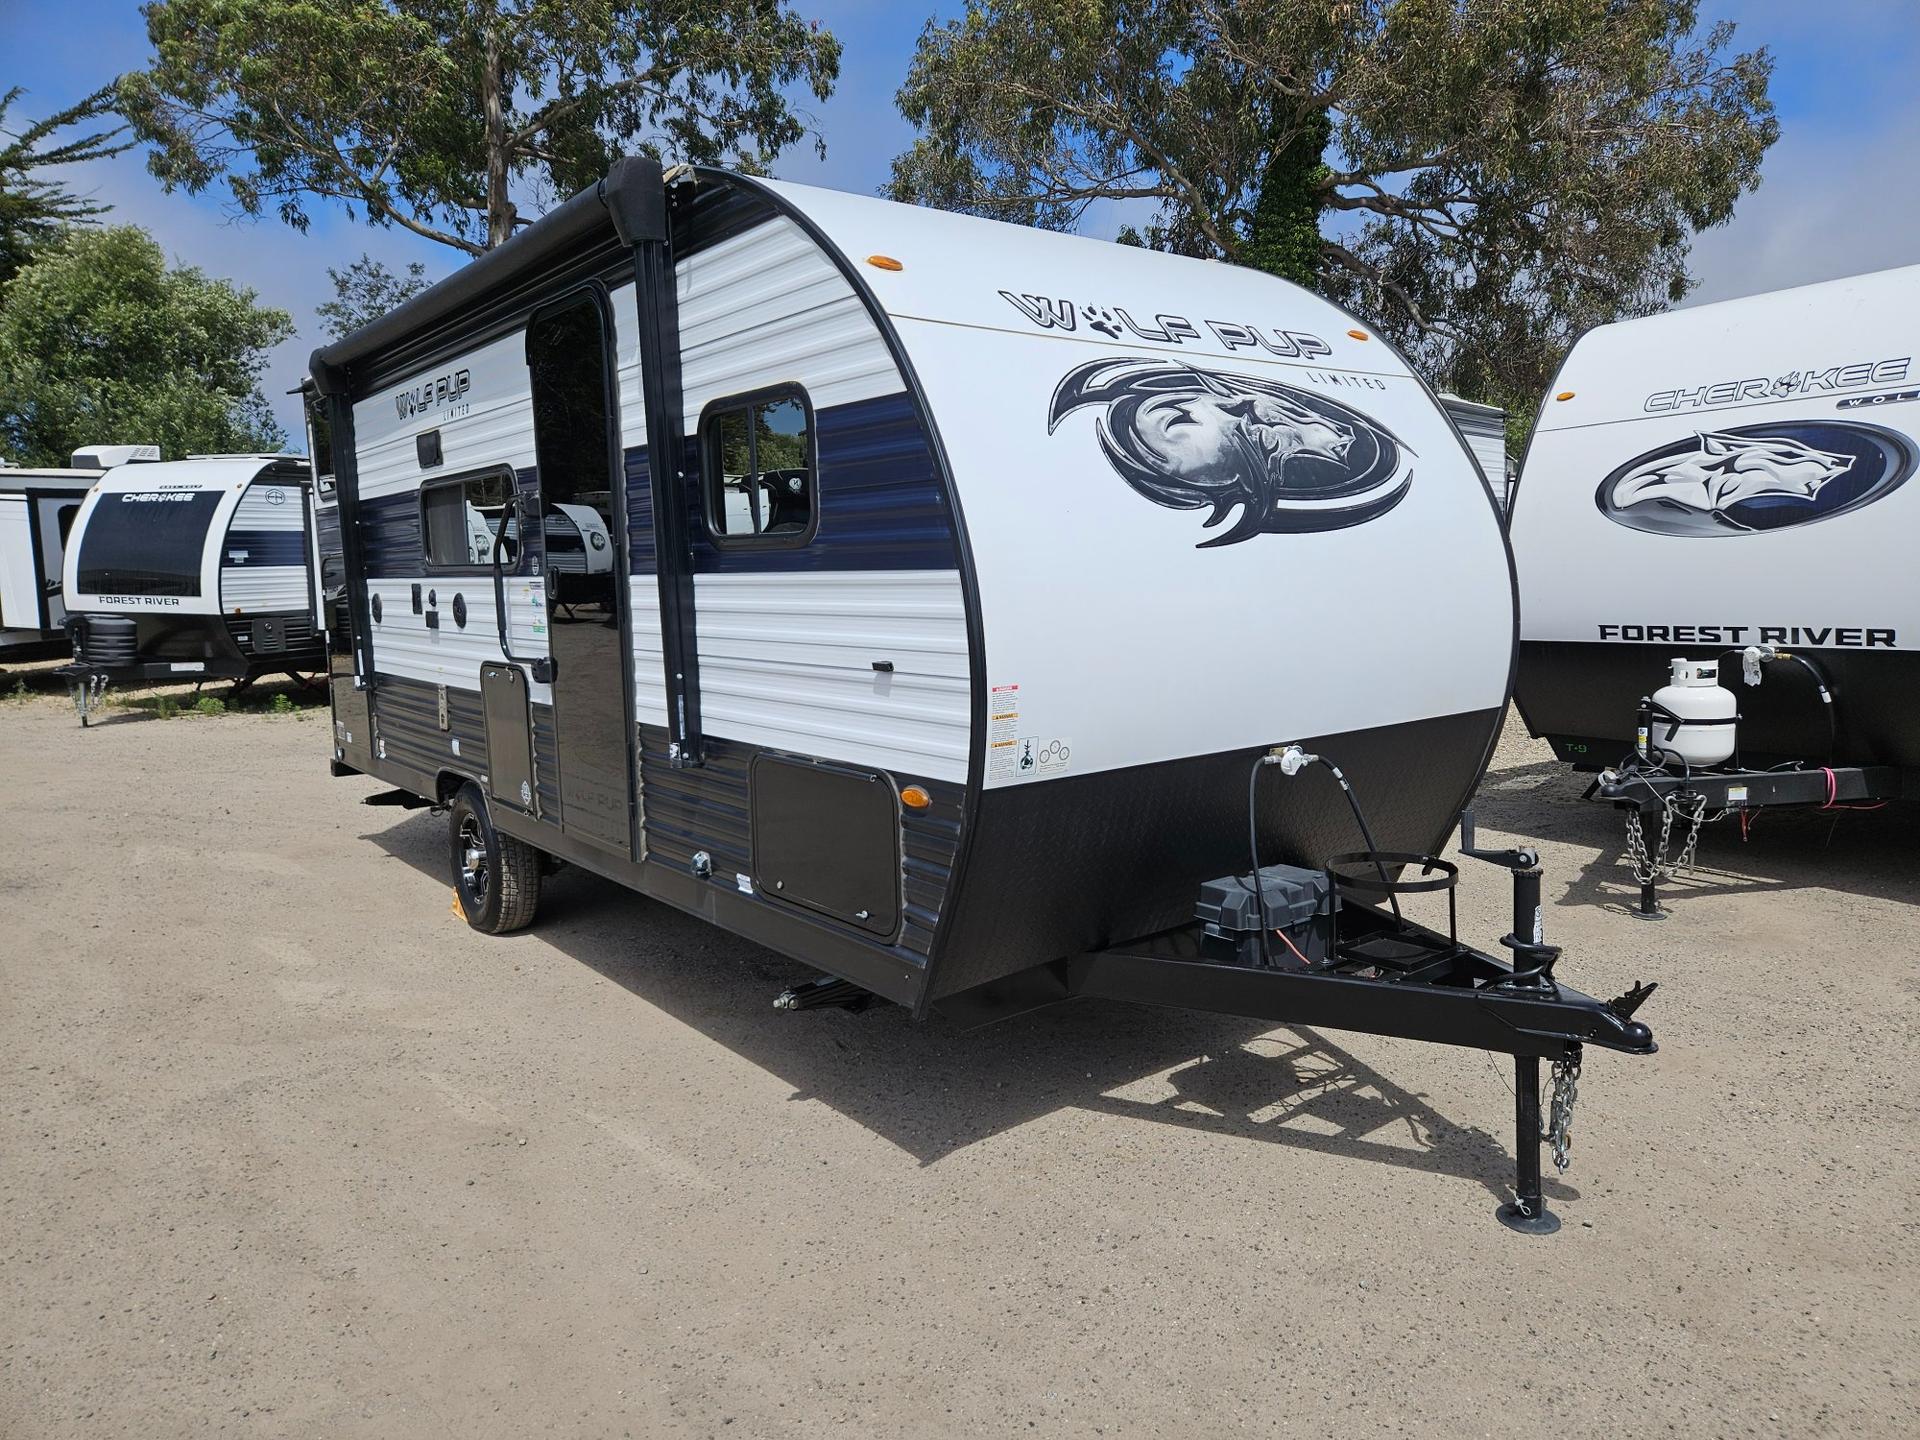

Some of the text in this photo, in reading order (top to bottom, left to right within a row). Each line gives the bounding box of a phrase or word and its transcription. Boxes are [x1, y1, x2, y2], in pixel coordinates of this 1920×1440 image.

[1205, 319, 1333, 360] PUP
[436, 368, 470, 407] PUP
[1305, 371, 1385, 391] LIMITED
[1643, 357, 1912, 413] CHEROKEE
[1848, 391, 1920, 407] WOL
[443, 403, 470, 421] LIMITED
[121, 492, 196, 503] CHEROKEE
[98, 596, 180, 606] FOREST RIVER
[1598, 624, 1897, 647] FOREST RIVER
